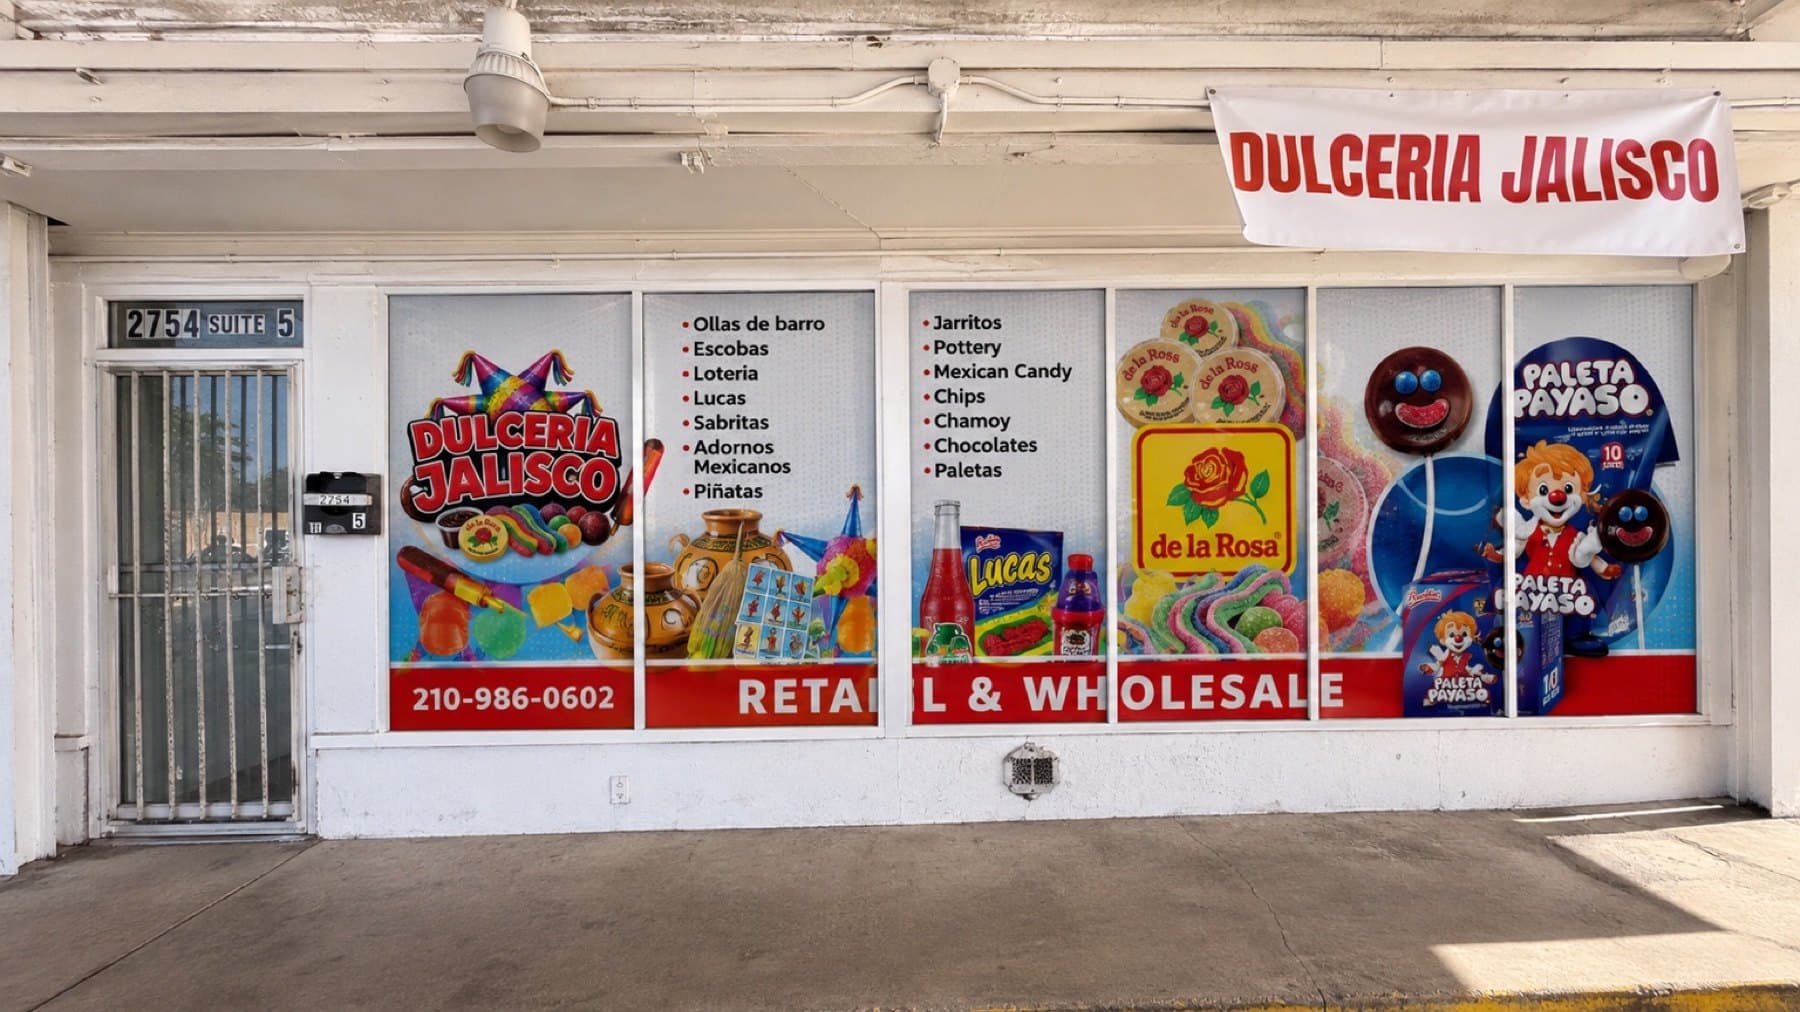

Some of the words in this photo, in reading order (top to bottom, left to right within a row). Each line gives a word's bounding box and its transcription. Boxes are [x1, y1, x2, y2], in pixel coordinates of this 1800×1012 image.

[1230, 131, 1481, 203] DULCERIA
[1501, 136, 1720, 204] JALISCO
[128, 310, 199, 338] 2754
[209, 315, 264, 334] SUITE
[278, 309, 293, 337] 5
[693, 315, 741, 332] Ollas
[746, 315, 770, 332] de
[775, 315, 826, 332] barro
[933, 313, 1002, 331] Jarritos
[694, 339, 769, 357] Escobas
[934, 339, 1002, 359] Pottery
[694, 364, 759, 382] Loteria
[934, 362, 1009, 379] Mexican
[1014, 362, 1073, 382] Candy
[1523, 359, 1634, 389] PALETA
[694, 390, 747, 406] Lucas
[934, 387, 986, 407] Chips
[1514, 383, 1649, 418] PAYASO
[694, 413, 770, 431] Sabritas
[934, 411, 1010, 432] Chamoy
[409, 411, 620, 461] DULCERIA
[934, 436, 1038, 454] Chocolates
[693, 438, 775, 456] Adornos
[1603, 445, 1622, 461] 10
[694, 458, 792, 475] Mexicanos
[934, 461, 1003, 478] Paletas
[412, 451, 617, 514] JALISCO
[694, 481, 764, 499] Piñatas
[320, 495, 350, 505] 2754
[355, 514, 363, 528] 5
[1150, 533, 1182, 559] de
[1186, 533, 1212, 558] la
[970, 552, 1052, 598] Lucas
[1515, 573, 1587, 595] PALETA
[1434, 677, 1482, 689] PALETA
[412, 686, 615, 711] 210-986-0602
[738, 677, 947, 714] RETAIL
[968, 676, 1002, 712] &
[1023, 673, 1344, 711] WHOLESALE
[1428, 689, 1489, 702] PAYASO
